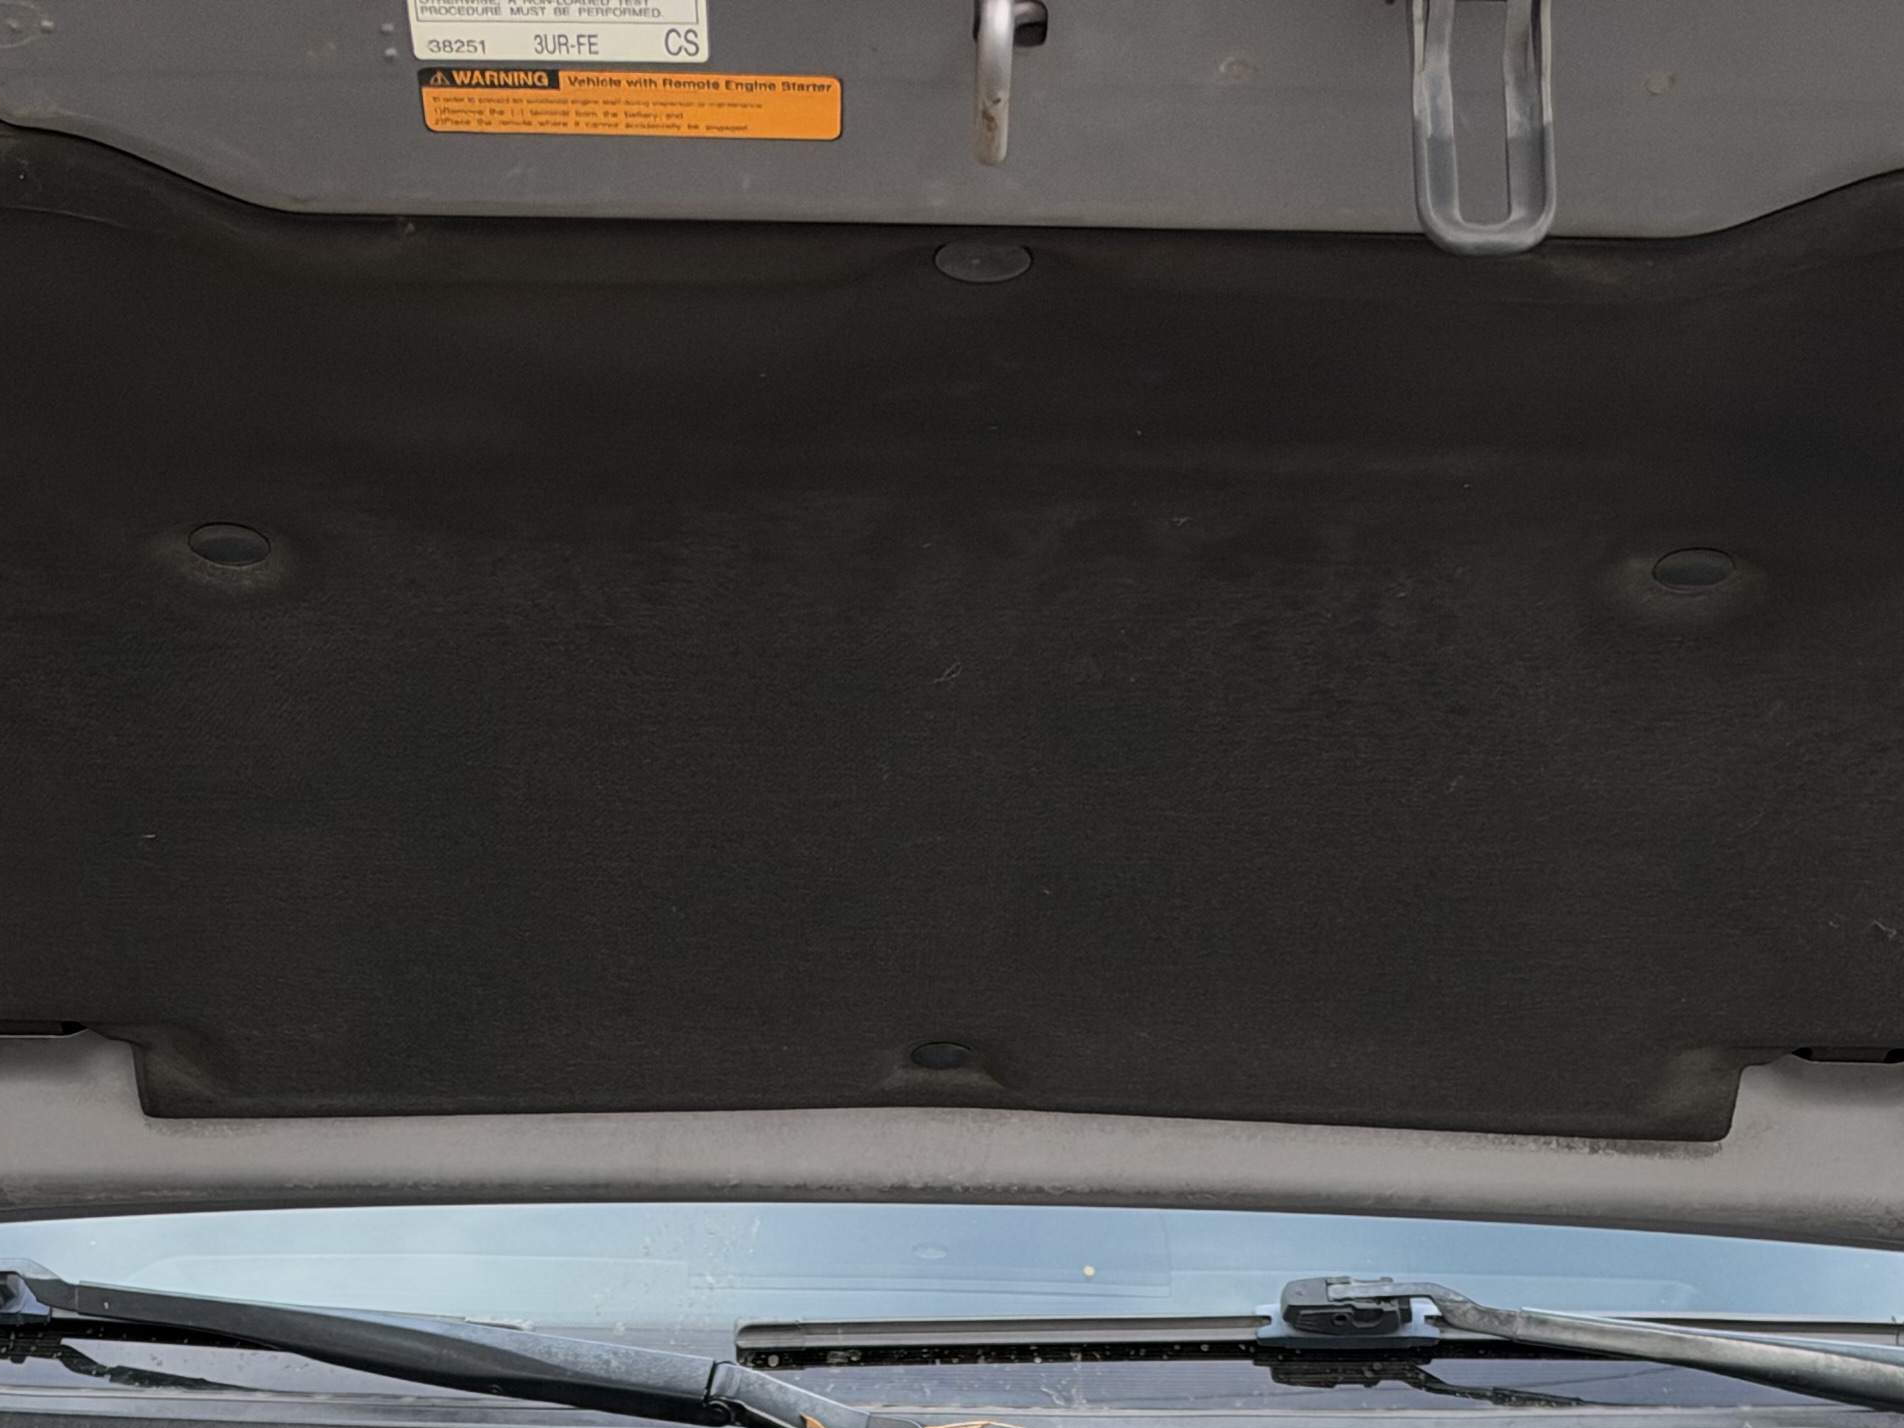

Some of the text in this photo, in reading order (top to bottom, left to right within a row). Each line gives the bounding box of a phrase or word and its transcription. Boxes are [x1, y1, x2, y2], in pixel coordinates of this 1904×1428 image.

[420, 6, 502, 16] PROCEDURE
[510, 6, 546, 16] MUST
[553, 7, 570, 17] BE
[427, 28, 700, 57] 38251 3UR-FE CS
[451, 70, 832, 93] WARNING Vehicle with Remote Engine Starter
